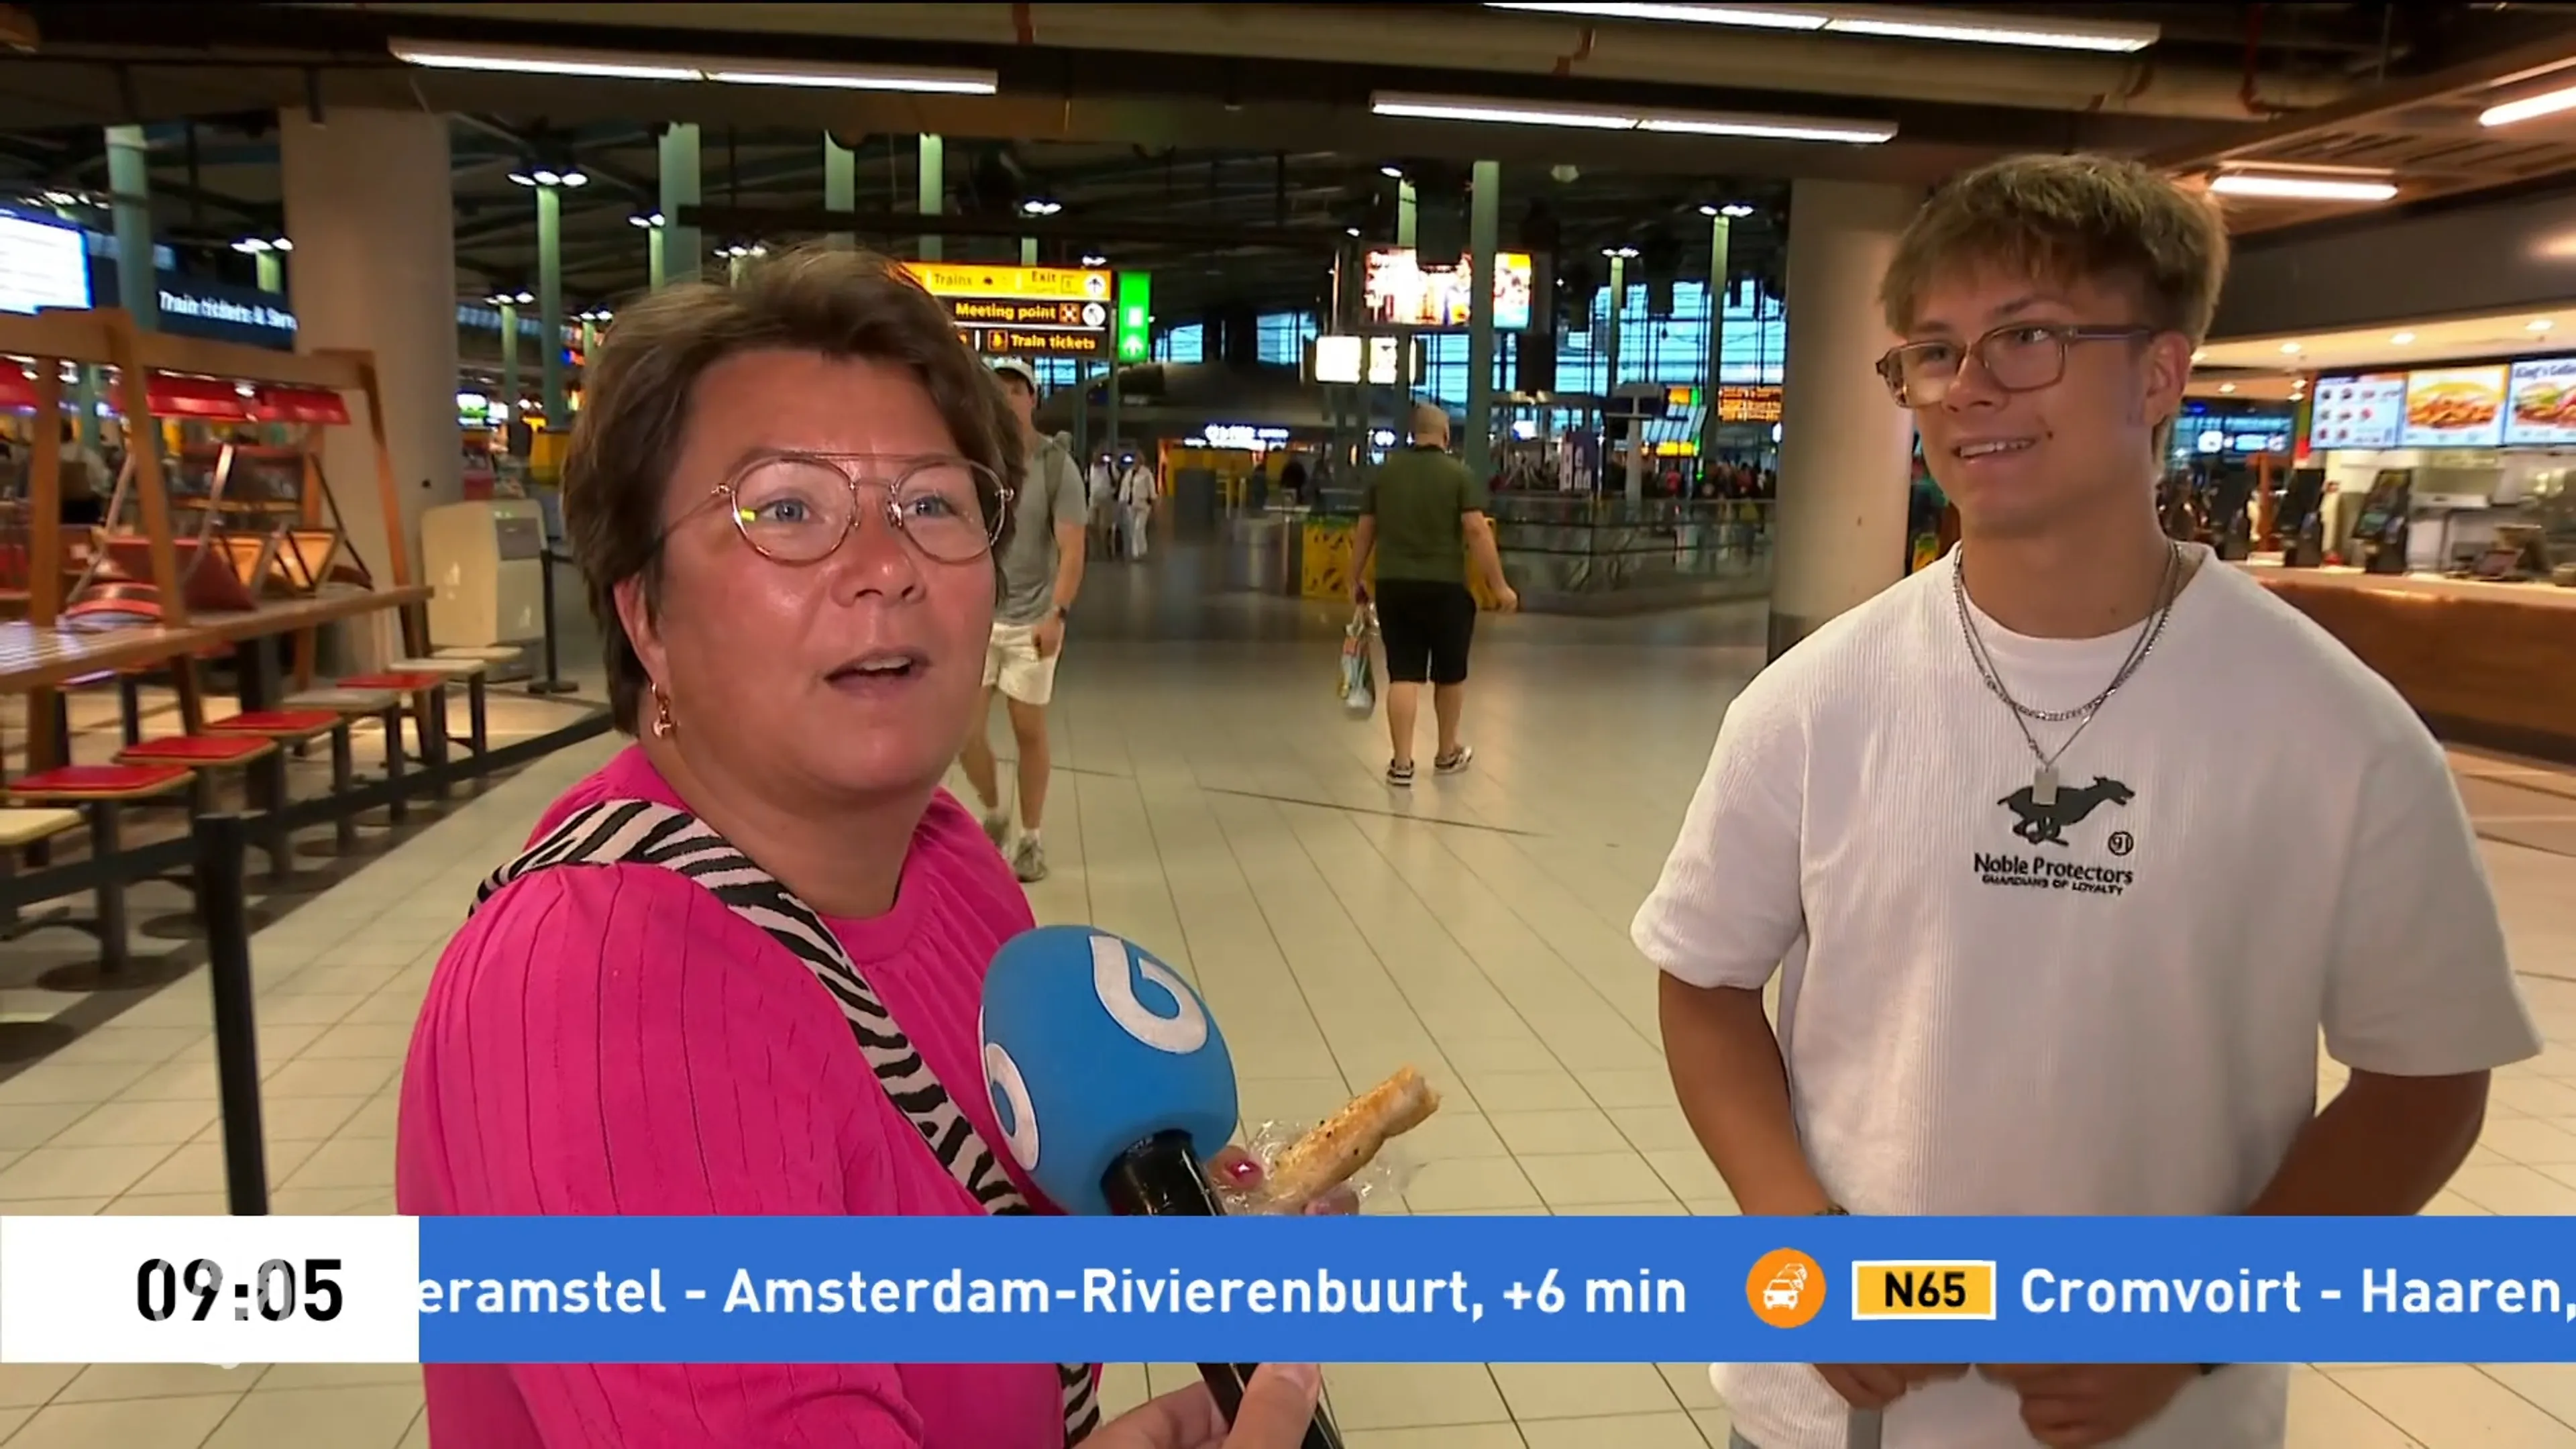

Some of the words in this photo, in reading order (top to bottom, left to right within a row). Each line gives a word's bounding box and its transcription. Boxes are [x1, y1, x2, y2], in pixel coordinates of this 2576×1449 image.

[1031, 270, 1056, 283] Exit
[955, 303, 1014, 321] Meeting
[1018, 305, 1056, 321] point
[1010, 334, 1046, 347] Train
[1050, 336, 1095, 350] tickets
[1974, 853, 2028, 875] Noble
[2033, 856, 2134, 886] Protectors
[2053, 878, 2069, 889] OF
[2073, 882, 2123, 896] LOYALTY
